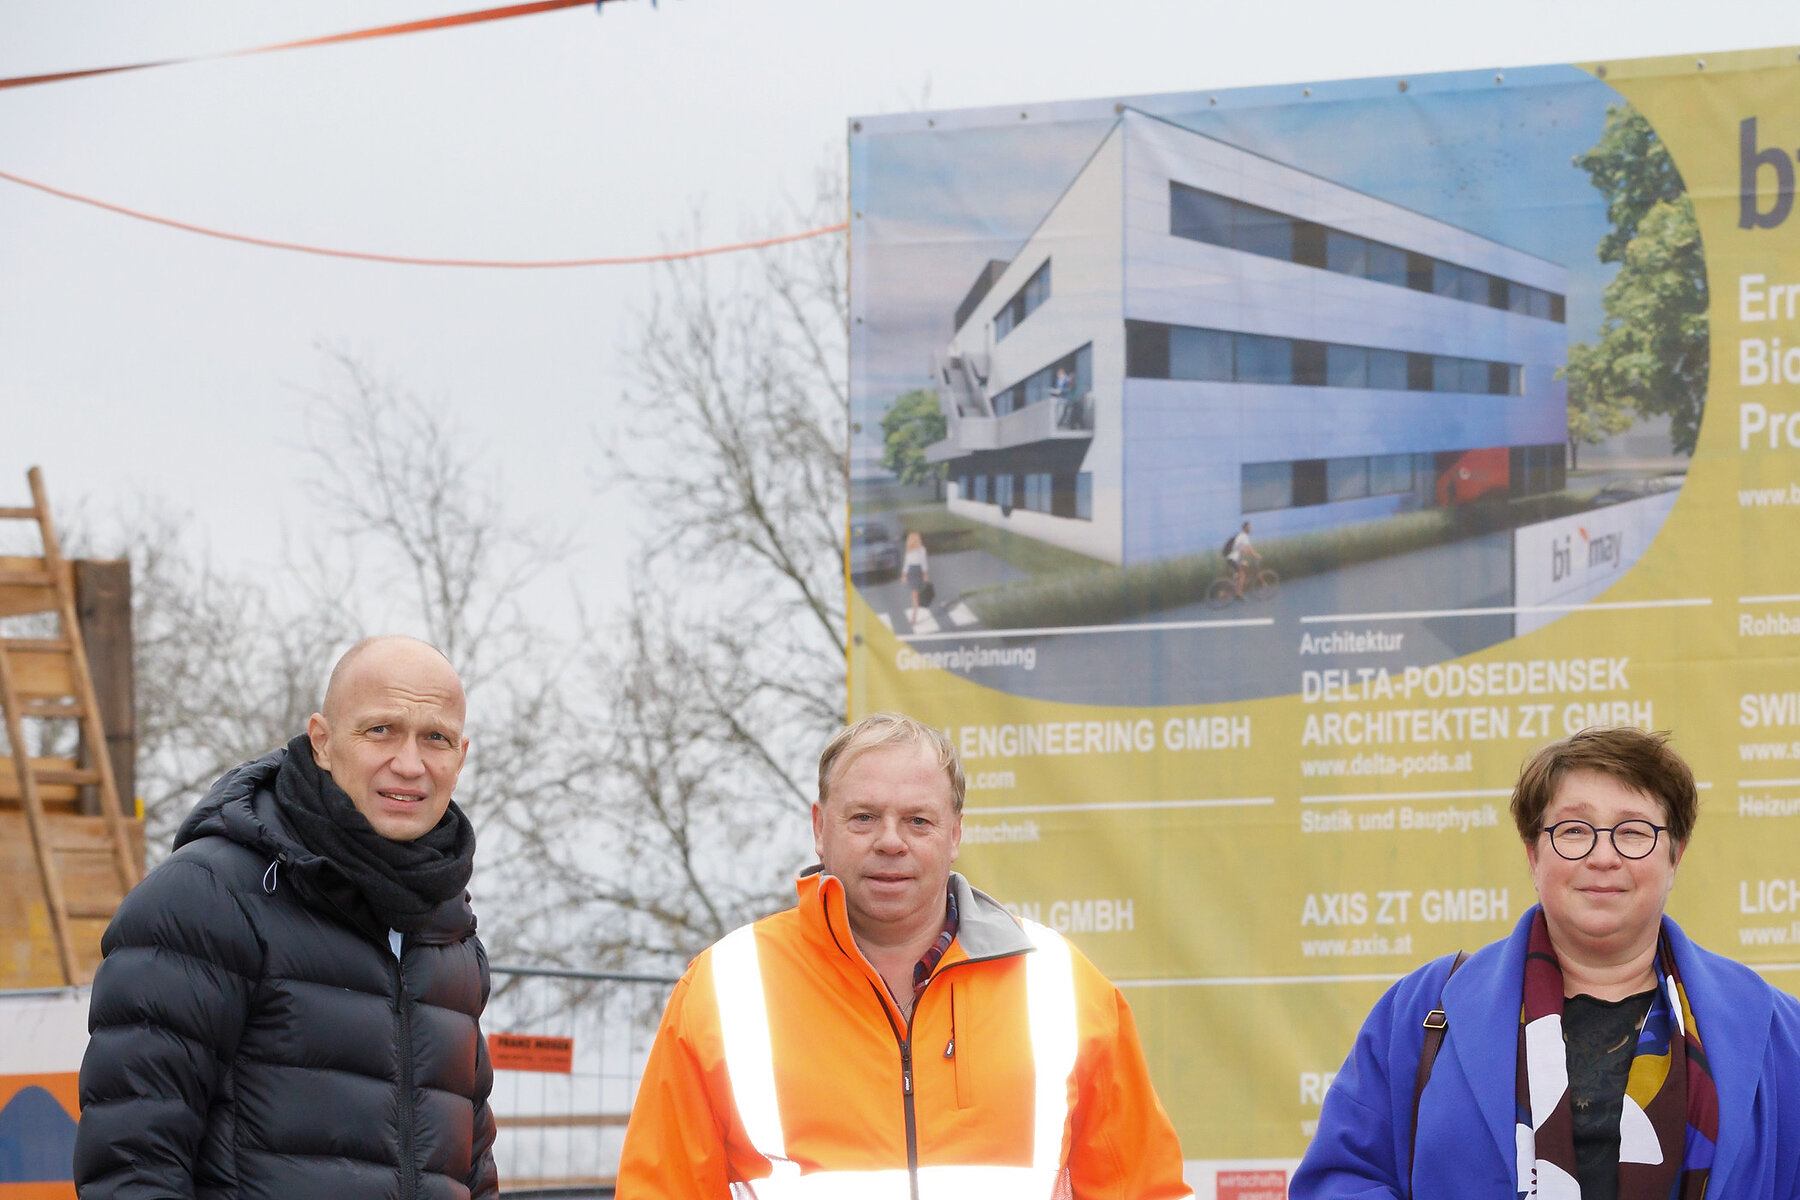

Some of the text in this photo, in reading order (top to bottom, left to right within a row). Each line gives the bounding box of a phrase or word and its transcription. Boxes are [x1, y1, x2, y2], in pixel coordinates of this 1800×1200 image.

[1300, 629, 1405, 655] Architektur
[896, 646, 1037, 672] Generalplanung
[1302, 657, 1630, 704] DELTA-PODSEDENSEK
[960, 715, 1252, 759] ENGINEERING GMBH
[1302, 706, 1510, 747] ARCHITEKTEN
[1517, 704, 1556, 739] ZT
[1301, 751, 1473, 778] www.delta-pods.at
[1301, 804, 1499, 834] Statik und Bauphysik
[1050, 898, 1135, 934] GMBH
[1301, 888, 1510, 927] AXIS ZT GMBH
[1301, 933, 1413, 957] www.axis.at
